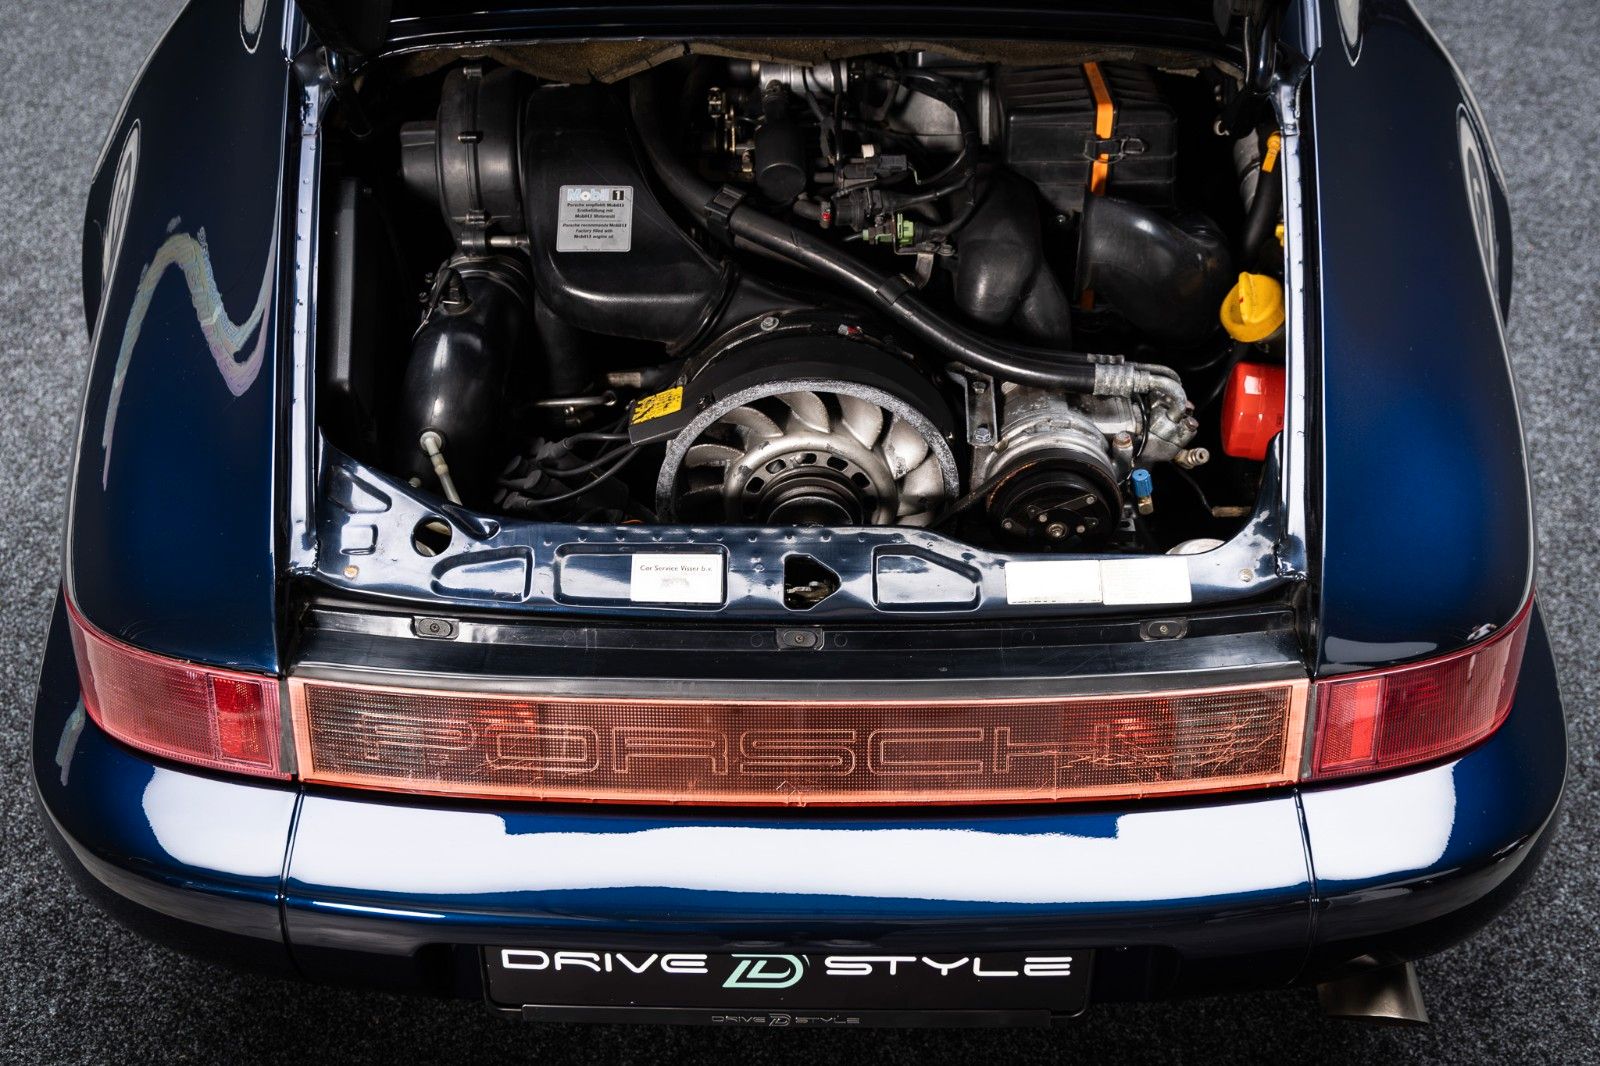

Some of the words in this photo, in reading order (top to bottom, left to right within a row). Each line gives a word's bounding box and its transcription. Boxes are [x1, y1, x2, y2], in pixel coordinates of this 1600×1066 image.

[567, 188, 609, 201] Mobil
[501, 948, 708, 974] DRIVE
[824, 955, 1073, 977] STYLE
[711, 1015, 766, 1023] DRIVE
[795, 1016, 860, 1024] STYLE
